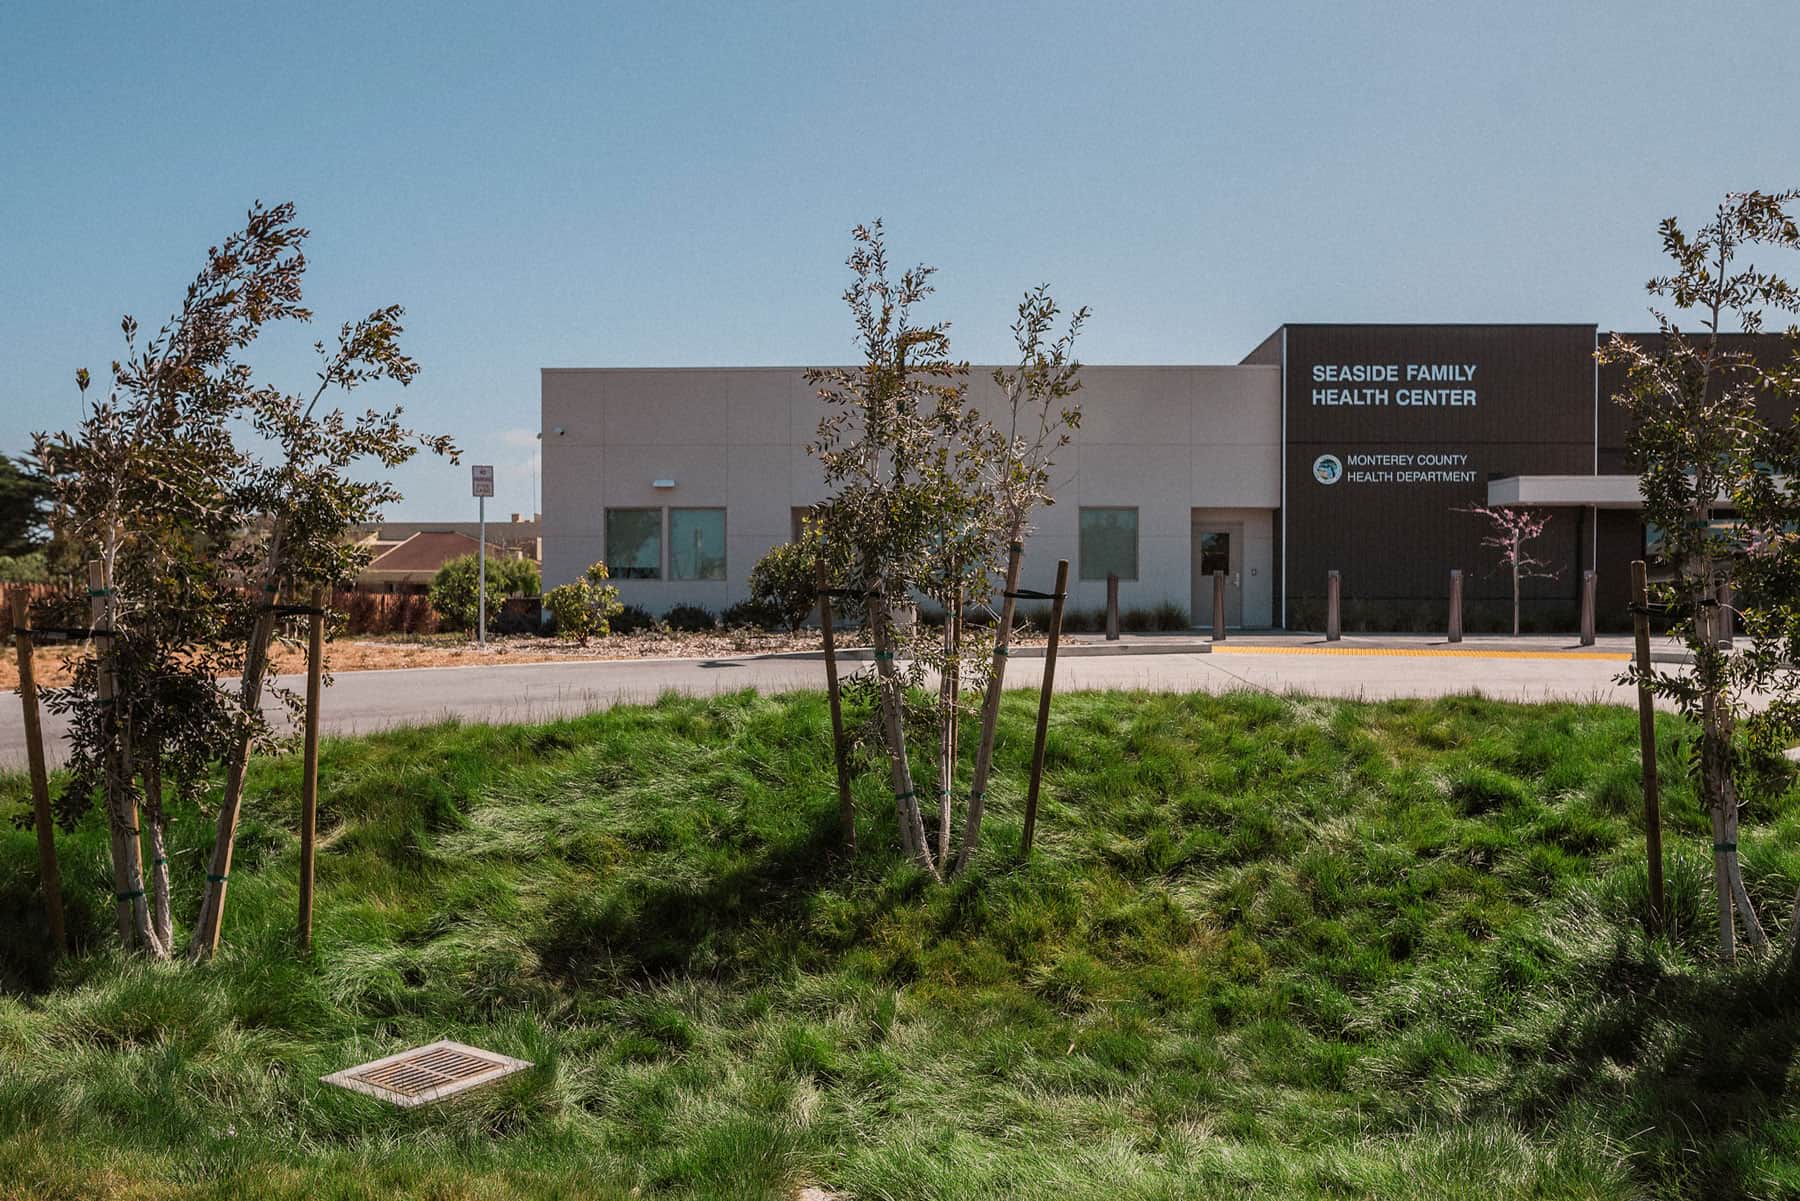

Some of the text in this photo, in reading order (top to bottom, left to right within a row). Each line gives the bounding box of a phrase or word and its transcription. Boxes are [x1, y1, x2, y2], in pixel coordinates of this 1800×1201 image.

[1312, 364, 1477, 382] SEASIDE FAMILY
[1312, 389, 1477, 406] HEALTH CENTER
[1347, 454, 1468, 466] MONTEREY COUNTY
[1347, 471, 1477, 482] HEALTH DEPARTMENT
